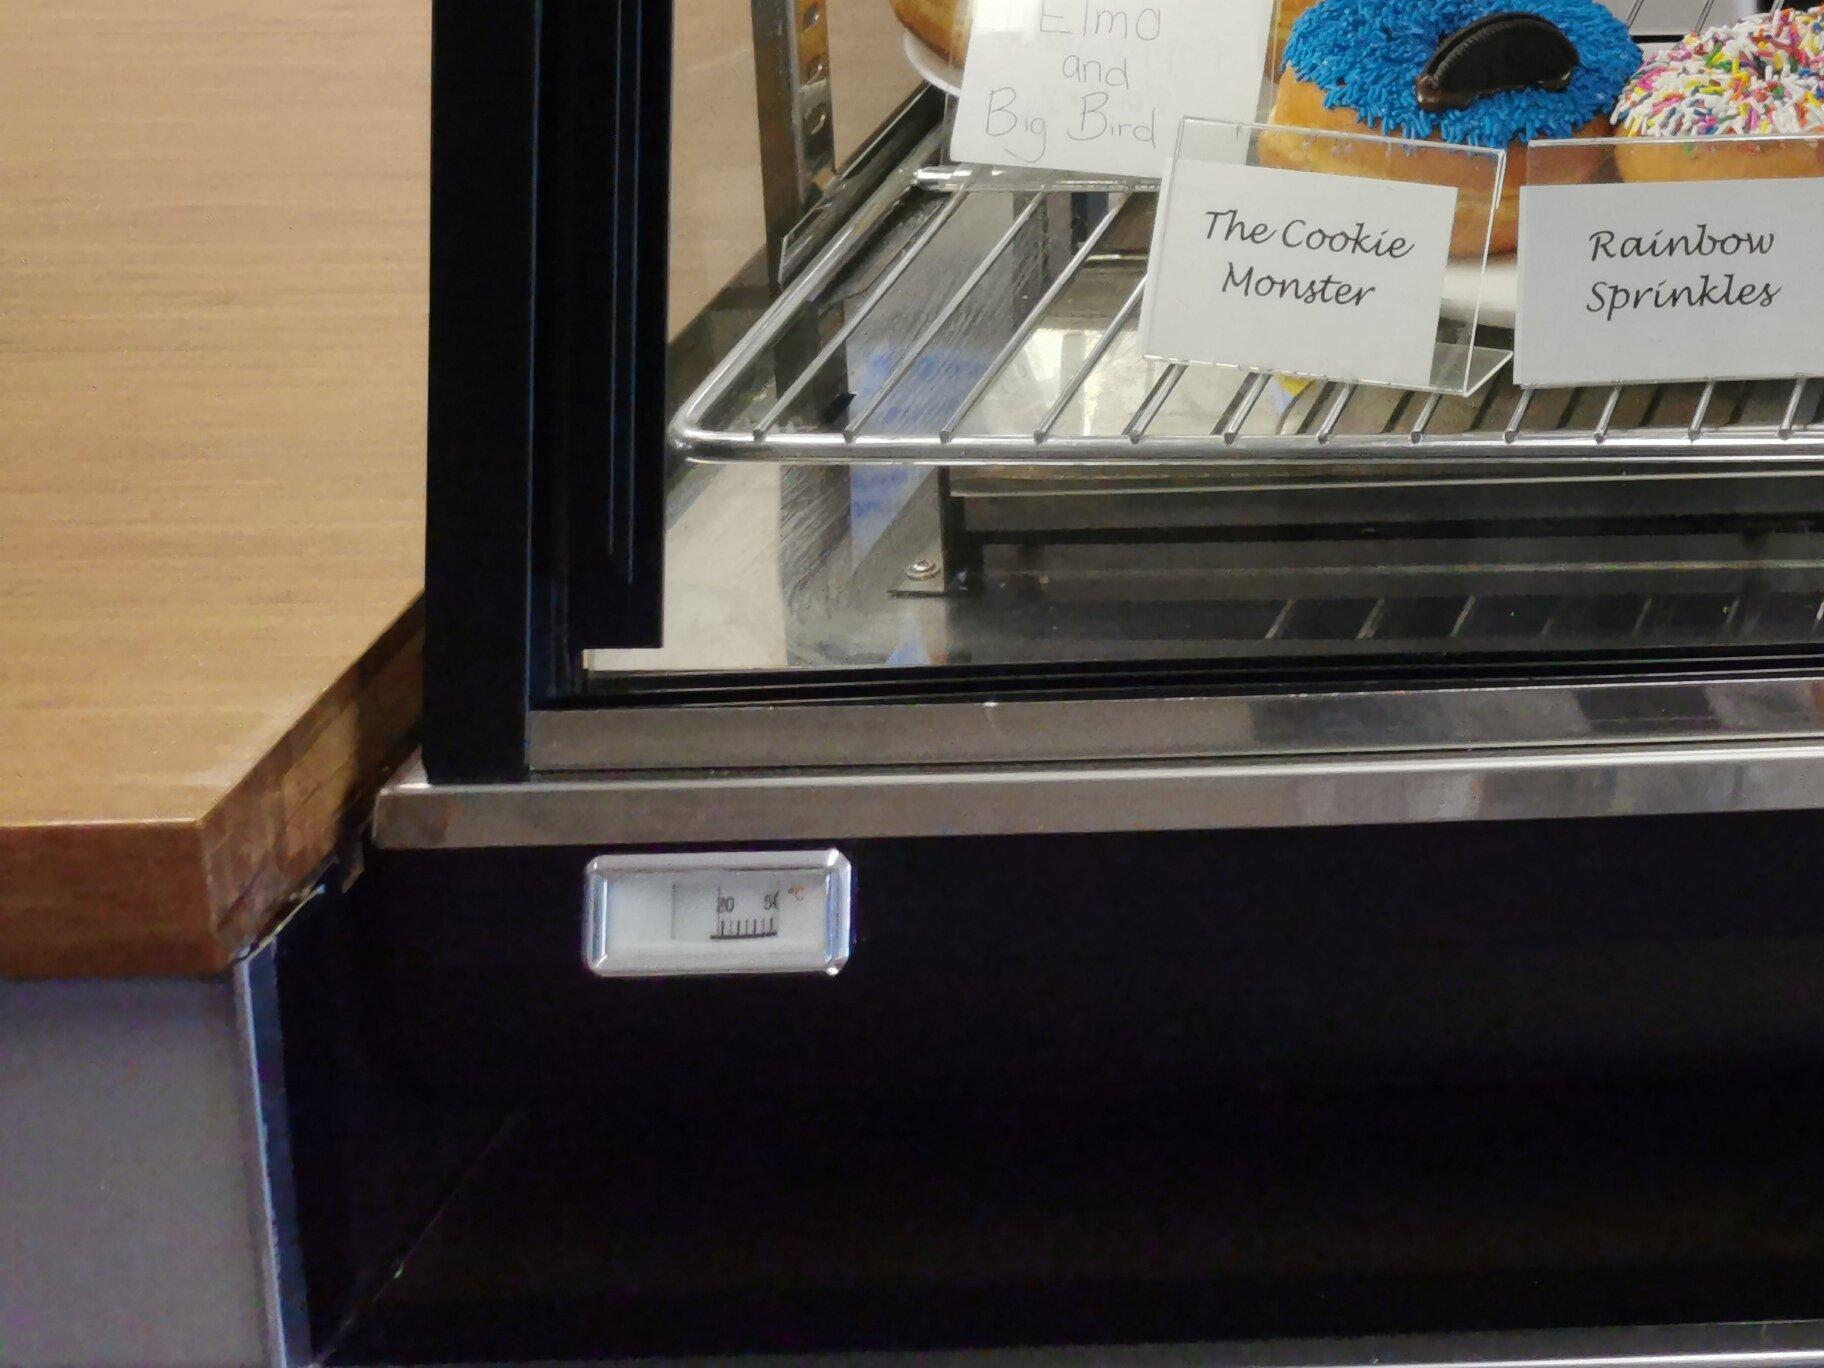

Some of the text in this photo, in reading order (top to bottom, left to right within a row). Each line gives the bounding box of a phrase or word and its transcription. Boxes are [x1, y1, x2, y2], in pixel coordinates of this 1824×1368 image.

[1062, 54, 1129, 90] and
[985, 86, 1156, 163] Big Bird
[1204, 209, 1416, 260] The Cookie
[1588, 224, 1776, 263] Rainbow
[1221, 262, 1377, 307] Monster
[1585, 274, 1782, 320] Sprinkles
